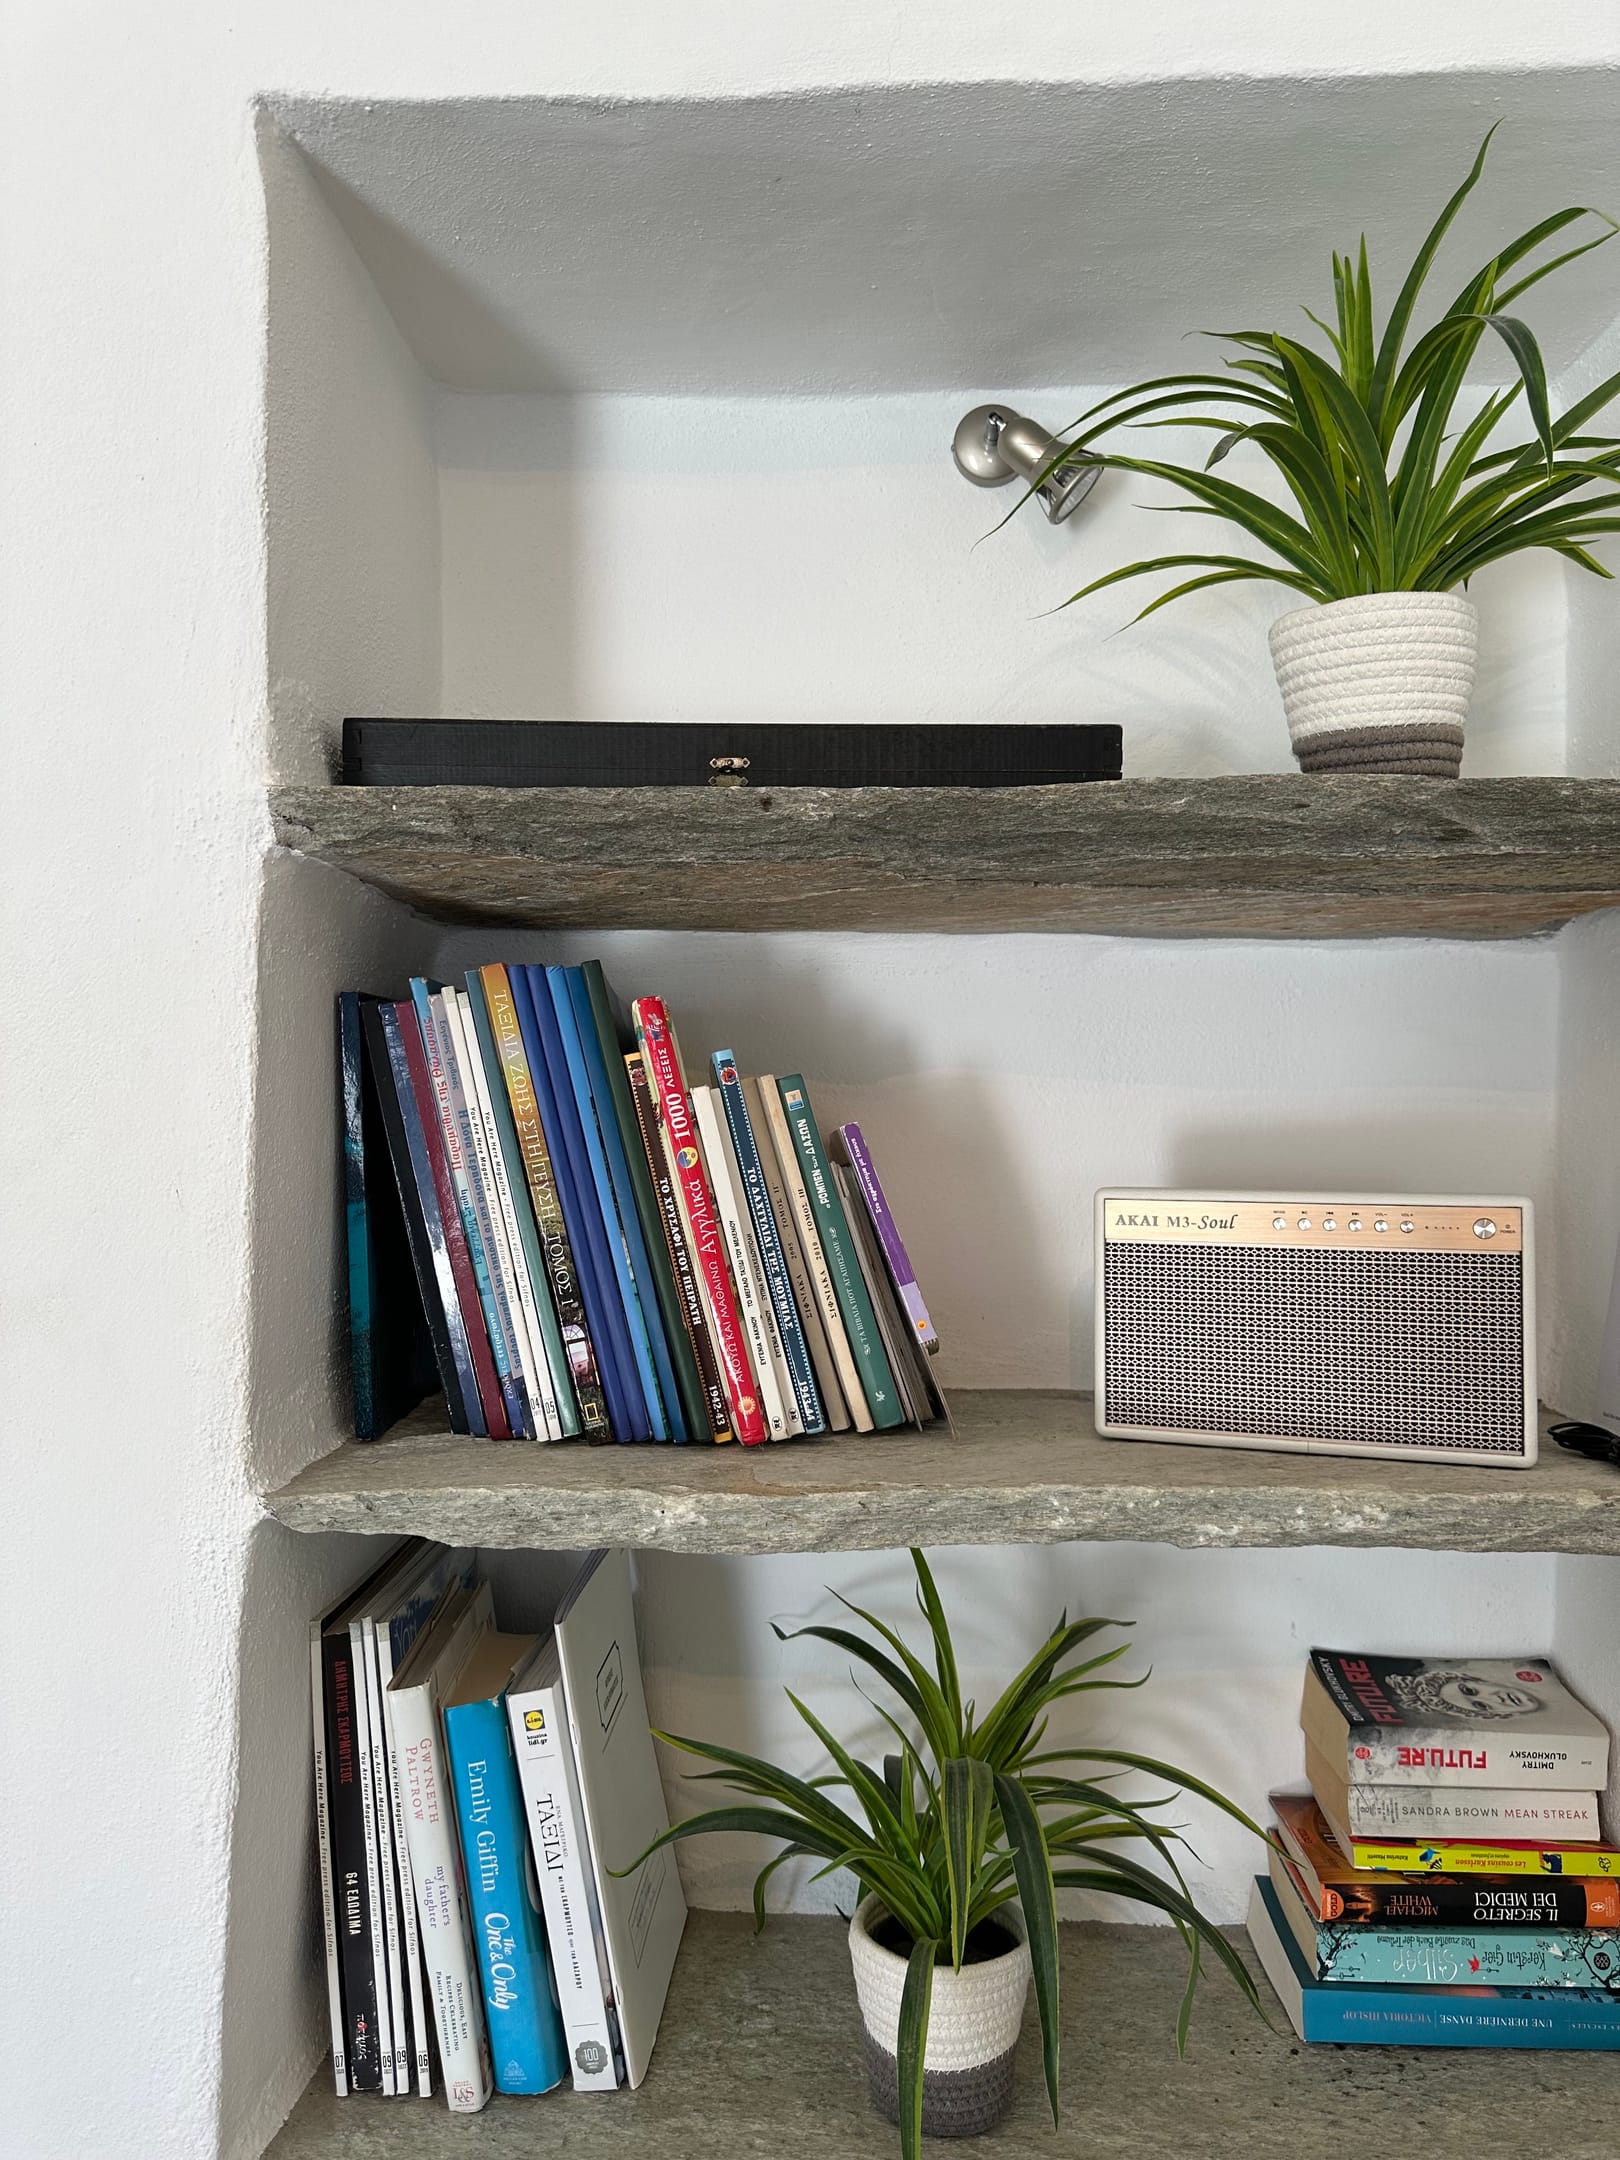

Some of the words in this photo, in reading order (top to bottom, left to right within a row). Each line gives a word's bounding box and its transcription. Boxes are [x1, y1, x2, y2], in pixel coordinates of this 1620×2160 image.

[494, 989, 520, 1059] ΤΑΞΙΔΙΑ
[418, 1015, 444, 1078] Θάλασσας
[657, 1047, 675, 1087] ΛΕΞΕΙΣ
[434, 1080, 449, 1102] της
[509, 1062, 532, 1114] ΖΩΗΣ
[458, 1109, 467, 1118] Η
[665, 1093, 690, 1139] 1000
[438, 1105, 464, 1170] Παραμύθια
[460, 1120, 474, 1148] Δόνα
[521, 1118, 542, 1157] ΣΤΗ
[796, 1118, 815, 1154] ΔΑΣΩΝ
[858, 1157, 866, 1166] με
[467, 1152, 486, 1203] Τερηδόνα
[495, 1160, 506, 1195] Magazine
[659, 1177, 669, 1193] ΤΟ
[747, 1166, 757, 1182] ΤΟ
[531, 1161, 556, 1219] ΓΕΥΣΗ
[811, 1168, 829, 1204] ΡΟΜΠΕΝ
[457, 1188, 472, 1217] Στάθη
[479, 1205, 488, 1220] και
[775, 1198, 788, 1228] ΤΟΜΟΣ
[663, 1196, 682, 1246] ΧΡΥΣΑΦΙ
[684, 1178, 717, 1254] Αγγλικά
[751, 1186, 773, 1248] ΔΑΧΤΥΛΙΔΙ
[801, 1202, 814, 1231] ΤΟΜΟΣ
[1115, 1214, 1159, 1226] AKAI
[1167, 1214, 1238, 1230] M3-Soul
[479, 1156, 491, 1191] Magazine
[491, 1217, 501, 1236] press
[496, 1238, 506, 1264] edition
[505, 1280, 514, 1302] Sifnos
[483, 1223, 490, 1233] το
[484, 1235, 500, 1270] μυστικό
[676, 1249, 689, 1271] ΤΟΥ
[767, 1250, 779, 1273] ΤΗΣ
[787, 1241, 797, 1259] 2005
[812, 1241, 821, 1260] 2010
[547, 1232, 572, 1294] ΤΟΜΟΣ
[832, 1239, 850, 1286] ΑΓΑΠΗΣΑΜΕ
[495, 1273, 504, 1288] της
[708, 1260, 729, 1317] ΜΑΘΑΙΝΩ
[741, 1276, 751, 1298] ΜΕΓΑΛΟ
[682, 1275, 701, 1324] ΠΕΙΡΑΤΗ
[746, 1299, 753, 1307] ΤΟ
[773, 1276, 793, 1329] ΜΟΥΜΙΑΣ
[795, 1273, 812, 1319] ΣΙΦΝΙΑΚΑ
[819, 1269, 837, 1318] ΣΙΦΝΙΑΚΑ
[750, 1316, 760, 1339] ΦΑΚΙΝΟΥ
[764, 1310, 774, 1333] ΦΑΚΙΝΟΥ
[851, 1304, 863, 1330] ΒΙΒΛΙΑ
[488, 1312, 504, 1358] τετράγωνο
[722, 1321, 734, 1339] ΚΑΙ
[858, 1330, 867, 1342] ΤΑ
[756, 1342, 766, 1365] ΕΥΓΕΝΙΑ
[771, 1334, 781, 1357] ΕΥΓΕΝΙΑ
[727, 1342, 744, 1383] ΑΚΟΥΩ
[530, 1397, 540, 1409] 04
[545, 1401, 555, 1414] 05
[708, 1385, 725, 1425] 1942-43
[798, 1380, 815, 1420] 1943-44
[334, 1660, 349, 1714] ΔΗΜΗΤΡΗΣ
[337, 1716, 352, 1784] ΣΚΑΡΜΟΥΤΣΟΣ
[1397, 1747, 1487, 1769] FUTU.RE
[1509, 1750, 1567, 1760] GLUKHOVSKY
[1522, 1761, 1554, 1769] DMITRY
[405, 1746, 424, 1820] PALTROW
[419, 1737, 441, 1823] GWYNETH
[467, 1759, 491, 1824] Emily
[317, 1802, 326, 1839] Magazine
[1401, 1806, 1450, 1816] SANDRA
[1455, 1807, 1498, 1817] BROWN
[1504, 1809, 1538, 1818] MEAN
[1544, 1810, 1589, 1820] STREAK
[536, 1793, 563, 1871] ΤΑΞΙΔΙ
[558, 1821, 568, 1857] ΜΑΓΕΙΡΙΚΟ
[434, 1865, 444, 1881] my
[476, 1830, 498, 1893] Giffin
[1487, 1860, 1513, 1868] cousins
[345, 1872, 357, 1885] 64
[423, 1878, 437, 1928] daughter
[438, 1884, 451, 1926] father's
[1390, 1895, 1431, 1907] WHITE
[1474, 1892, 1528, 1906] MEDICI
[1532, 1892, 1556, 1906] DEI
[346, 1889, 360, 1934] ΕΔΩΔΙΜΑ
[1384, 1906, 1438, 1916] MICHAEL
[1474, 1908, 1541, 1920] SEGRETO
[1546, 1909, 1558, 1921] IL
[484, 1912, 513, 1950] One
[1402, 1936, 1415, 1946] der
[1416, 1936, 1433, 1947] Buch
[1434, 1936, 1460, 1946] zweite
[1461, 1937, 1475, 1948] Das
[489, 1951, 503, 1961] &
[502, 1936, 516, 1955] The
[1482, 1944, 1503, 1968] Gier
[1392, 1949, 1458, 1981] Silber
[1506, 1951, 1546, 1970] Kerstin
[488, 1962, 517, 2009] Only
[1342, 2010, 1380, 2020] HISLOP
[1383, 2012, 1432, 2023] VICTORIA
[1440, 2014, 1473, 2025] DANSE
[1476, 2015, 1528, 2028] DERNIÈRE
[1531, 2018, 1553, 2028] UNE
[335, 2055, 343, 2067] 07
[382, 2055, 392, 2068] 09
[396, 2050, 406, 2063] 09
[418, 2054, 428, 2066] 06
[584, 2048, 598, 2061] 100
